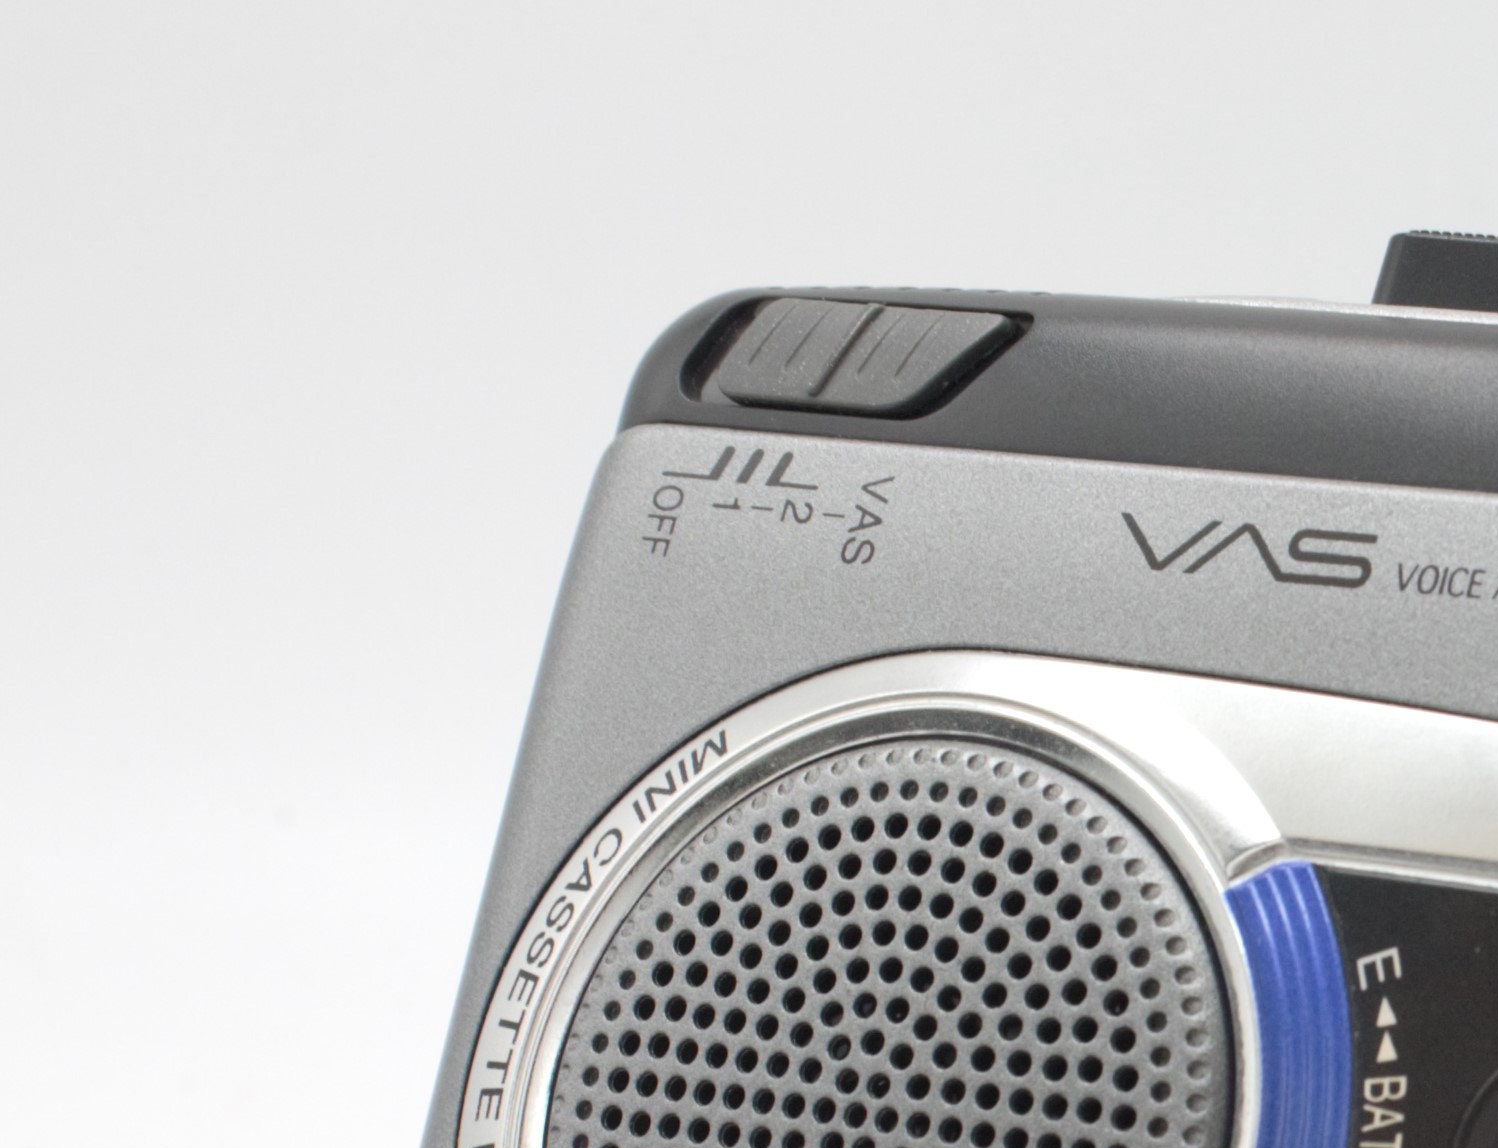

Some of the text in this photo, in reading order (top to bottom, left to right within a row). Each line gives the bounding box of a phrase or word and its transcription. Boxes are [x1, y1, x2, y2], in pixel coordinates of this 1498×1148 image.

[642, 476, 896, 565] OFF 1 2 VAS
[1120, 512, 1379, 588] VAS
[1397, 562, 1486, 598] VOICE
[632, 730, 729, 824] MINI
[475, 827, 625, 1122] CASSETTE
[1356, 946, 1402, 991] E
